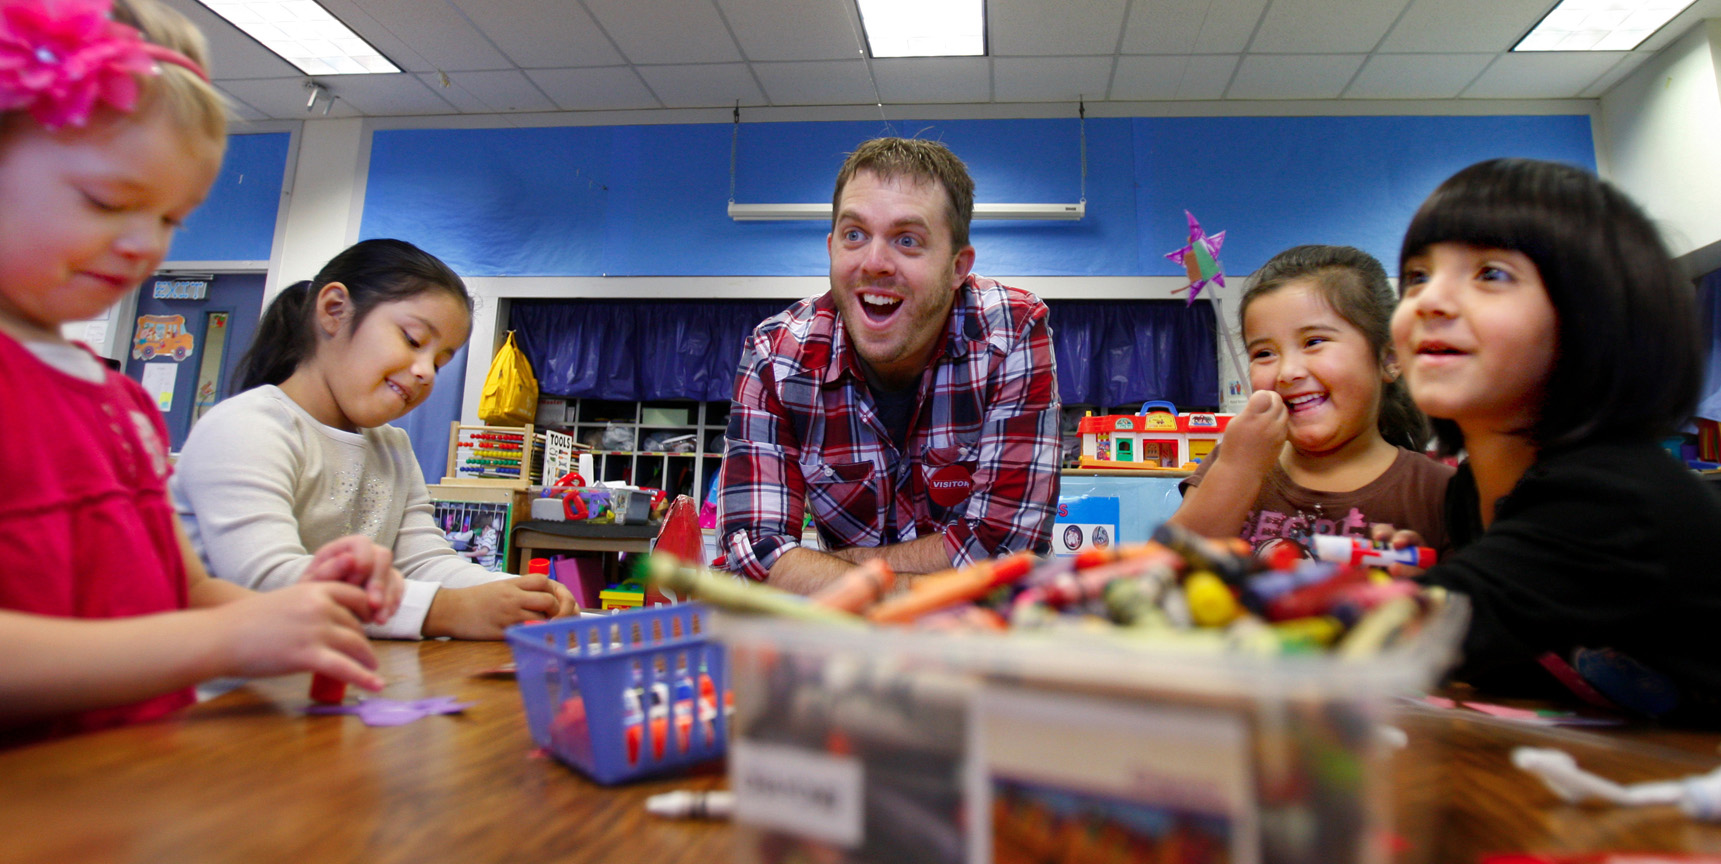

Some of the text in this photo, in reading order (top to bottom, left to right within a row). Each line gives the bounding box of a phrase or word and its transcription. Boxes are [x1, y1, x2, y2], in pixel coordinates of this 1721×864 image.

[155, 281, 204, 299] EXIT
[550, 433, 571, 449] TOOLS
[933, 480, 970, 488] VISITOR
